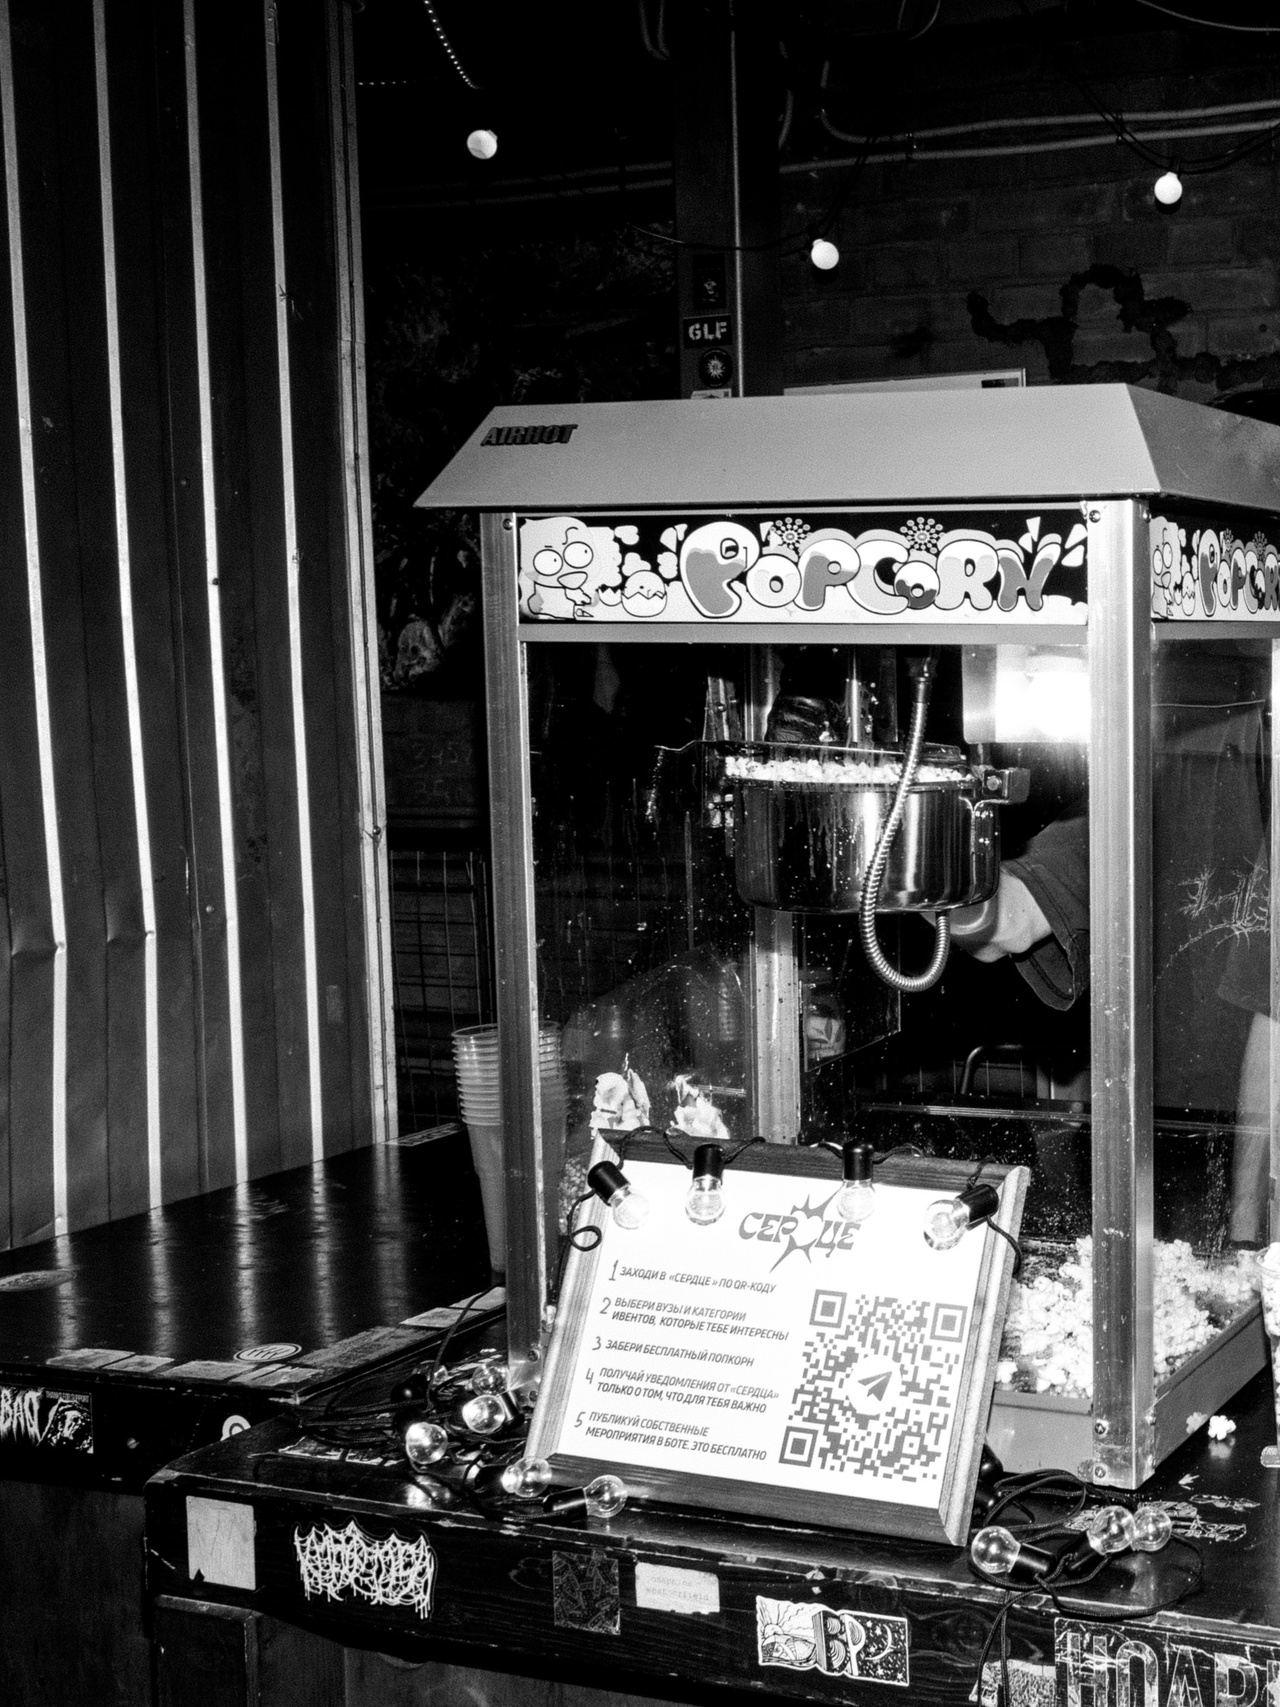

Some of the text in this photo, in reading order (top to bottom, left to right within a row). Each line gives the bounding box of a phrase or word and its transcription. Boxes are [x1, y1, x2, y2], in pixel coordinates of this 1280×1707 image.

[688, 321, 727, 341] GLF
[481, 424, 579, 446] AIRHOT
[680, 521, 1061, 618] POPCORN
[608, 1259, 619, 1281] 1
[619, 1266, 659, 1281] ЗАХОДИ
[659, 1271, 666, 1281] В
[719, 1278, 733, 1289] ПО
[733, 1279, 777, 1294] QR-КОДУ
[599, 1297, 747, 1322] 2 ВЫБЕРИ ВУЗЫ И КАТЕГОРИИ
[611, 1310, 789, 1341] ИВЕНТОВ, КОТОРЫЕ ТЕБЕ ИНТЕРЕСНЫ
[592, 1336, 755, 1368] 3 ЗАБЕРИ БЕСПЛАТНЫЙ ПОПКОРН
[585, 1368, 594, 1384] 4
[599, 1367, 645, 1382] ПОЛУЧАЙ
[645, 1373, 717, 1391] УВЕДОМЛЕНИЯ
[716, 1382, 731, 1393] ОТ
[596, 1381, 767, 1414] ТОЛЬКО О ТОМ, ЧТО ДЛЯ ТЕБЯ ВАЖНО
[574, 1411, 710, 1437] 5 ПУБЛИКУЙ СОБСТВЕННЫЕ
[585, 1426, 767, 1461] МЕРОПРИЯТИЯ В БОТЕ. ЭТО БЕСПЛАТНО
